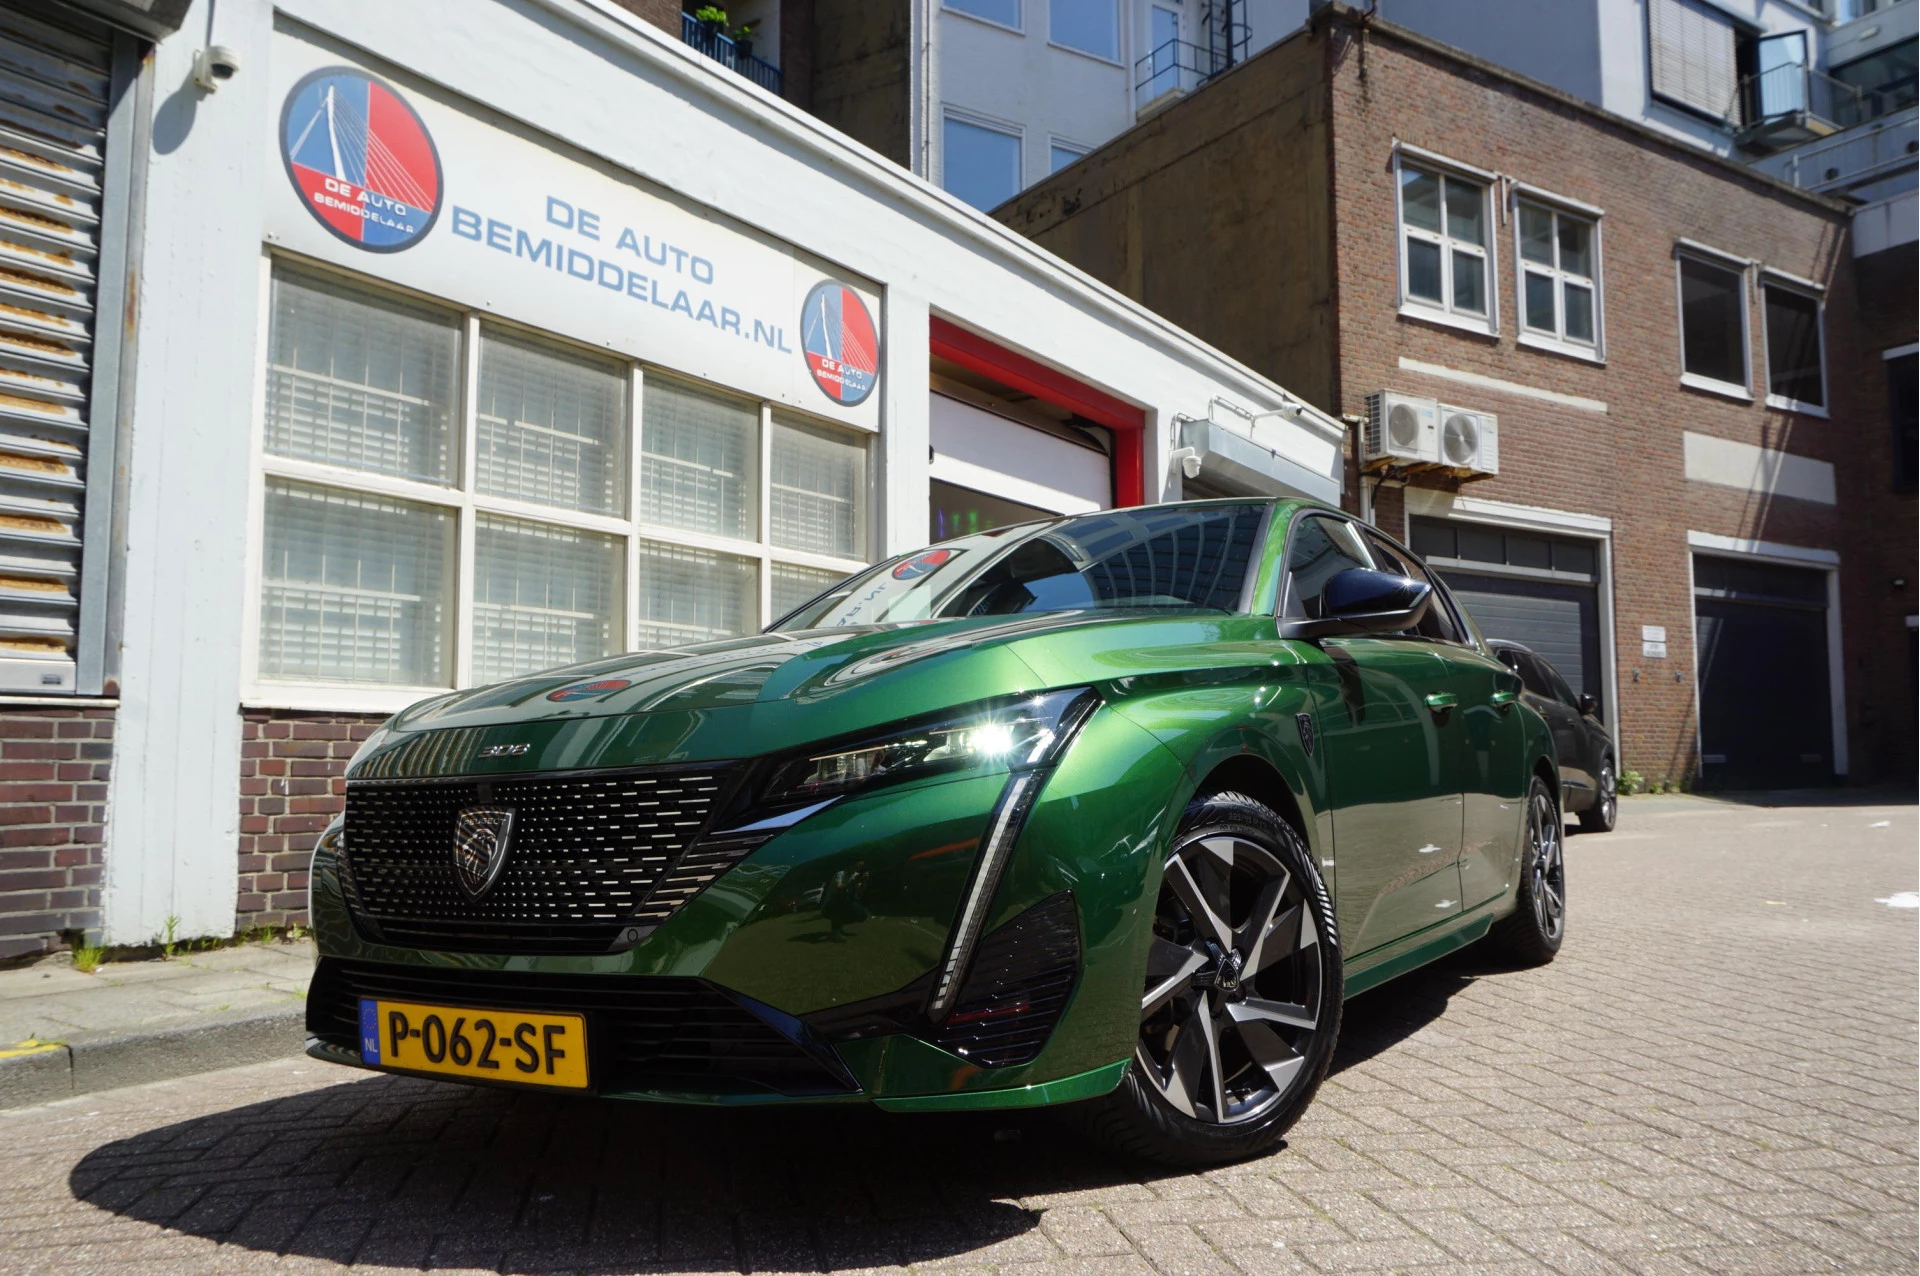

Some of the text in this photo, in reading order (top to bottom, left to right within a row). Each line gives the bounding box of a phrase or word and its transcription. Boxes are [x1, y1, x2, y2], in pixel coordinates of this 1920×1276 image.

[314, 191, 414, 234] BEMIDDELAAR
[324, 177, 407, 216] DE AUTO
[546, 195, 714, 286] DE AUTO
[451, 205, 793, 355] BEMIDDELAAR.NL
[821, 358, 863, 380] DE AUTO
[478, 743, 531, 759] 308
[364, 1037, 379, 1054] NL
[388, 1010, 566, 1076] P-062-SF
